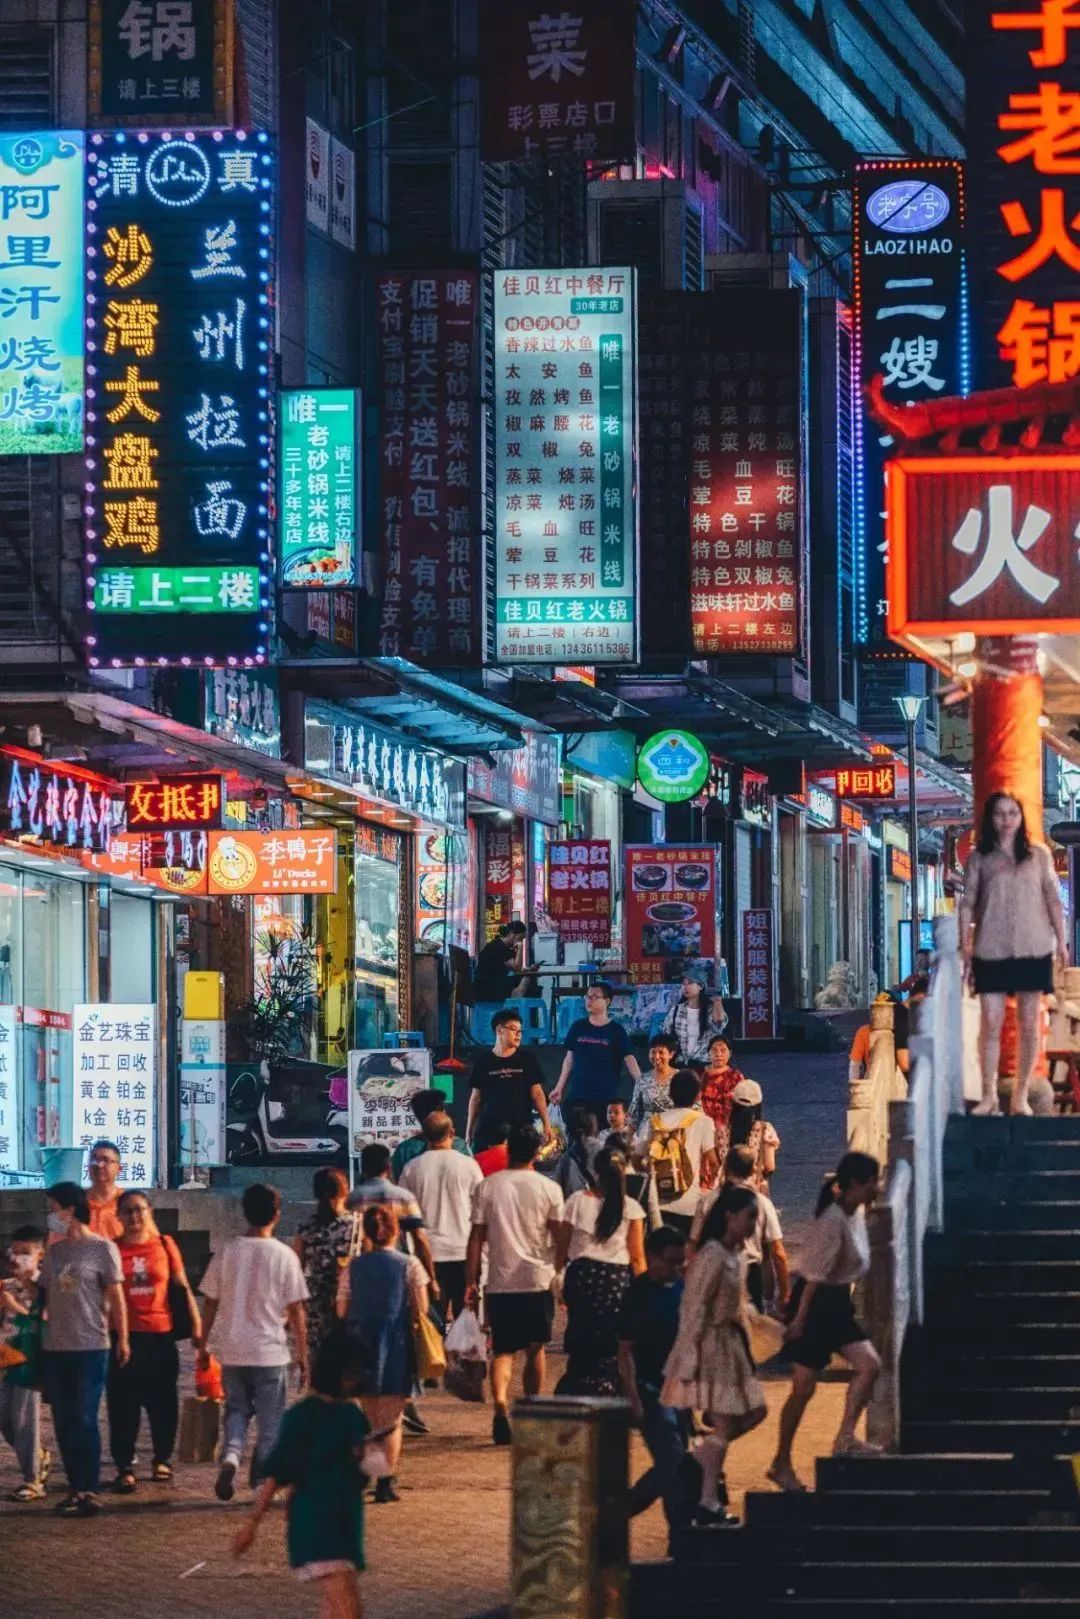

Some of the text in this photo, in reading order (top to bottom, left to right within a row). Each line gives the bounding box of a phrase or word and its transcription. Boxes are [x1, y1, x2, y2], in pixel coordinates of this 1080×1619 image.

[118, 0, 197, 60] 锅
[526, 11, 588, 83] 菜
[117, 77, 201, 100] 请上三楼
[96, 152, 140, 197] 清
[217, 149, 259, 193] 真
[864, 238, 953, 256] LAOZIHAO
[502, 274, 625, 297] 佳贝红中餐厅
[0, 184, 62, 423] 阿里汗烧烤
[575, 300, 620, 312] 30年老店
[505, 335, 593, 354] 香辣过水鱼
[184, 218, 248, 540] 兰州拉面
[505, 361, 595, 380] 太安鱼
[102, 223, 161, 554] 沙湾大盘鸡
[288, 394, 349, 423] 唯一
[505, 414, 594, 433] 椒麻腰花
[505, 441, 595, 459] 双椒兔
[601, 340, 622, 582] 唯一老砂锅米线
[693, 458, 795, 479] 毛血旺
[307, 424, 330, 544] 老砂锅米线
[284, 447, 303, 544] 三十多年老店
[506, 493, 596, 511] 凉菜 炖汤
[506, 519, 595, 538] 毛血旺
[692, 512, 795, 533] 特色干锅
[506, 546, 595, 565] 荤豆花
[691, 565, 794, 587] 特色双椒兔
[99, 572, 254, 608] 请上二楼
[503, 600, 628, 623] 佳贝红老火锅
[691, 591, 795, 612] 滋味轩过水鱼
[692, 622, 793, 637] 请上二楼左边
[258, 837, 334, 866] 李鸭子
[550, 871, 609, 890] 老火锅
[79, 1021, 151, 1042] 金艺珠宝
[80, 1052, 147, 1072] 加工 回收
[80, 1080, 147, 1100] 黄金 铂金
[116, 1107, 147, 1127] 钻石
[116, 1134, 147, 1154] 鉴定
